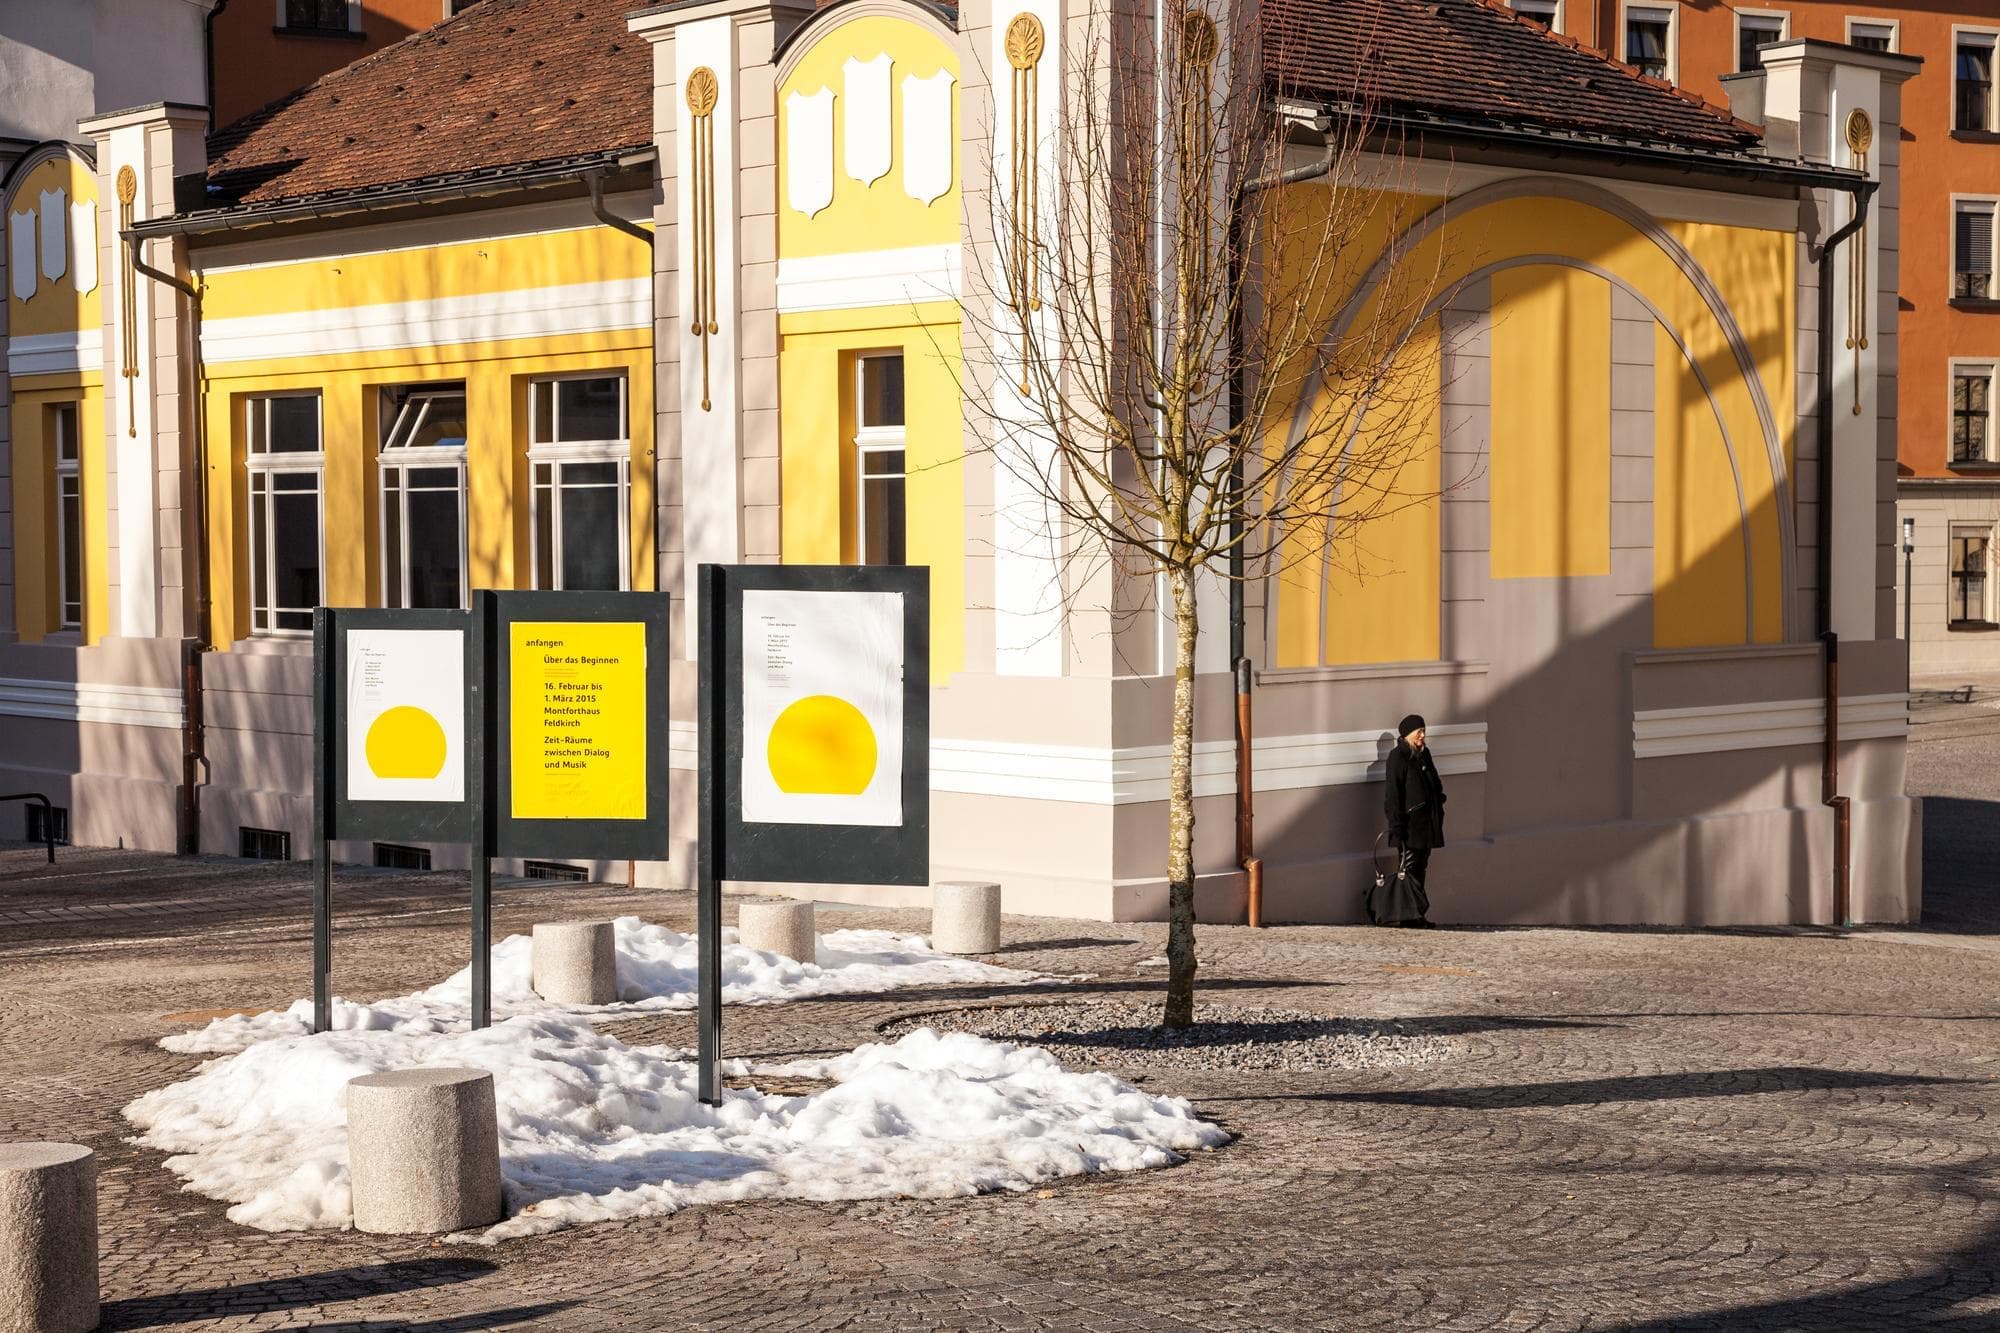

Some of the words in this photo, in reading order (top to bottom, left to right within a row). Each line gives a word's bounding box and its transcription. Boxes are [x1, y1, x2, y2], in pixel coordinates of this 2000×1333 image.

[526, 639, 563, 648] anfangen
[544, 655, 562, 663] Über
[581, 656, 618, 665] Beginnen
[544, 719, 580, 727] Feldkirch
[544, 736, 592, 744] Zeit-Räume
[585, 749, 609, 758] Dialog
